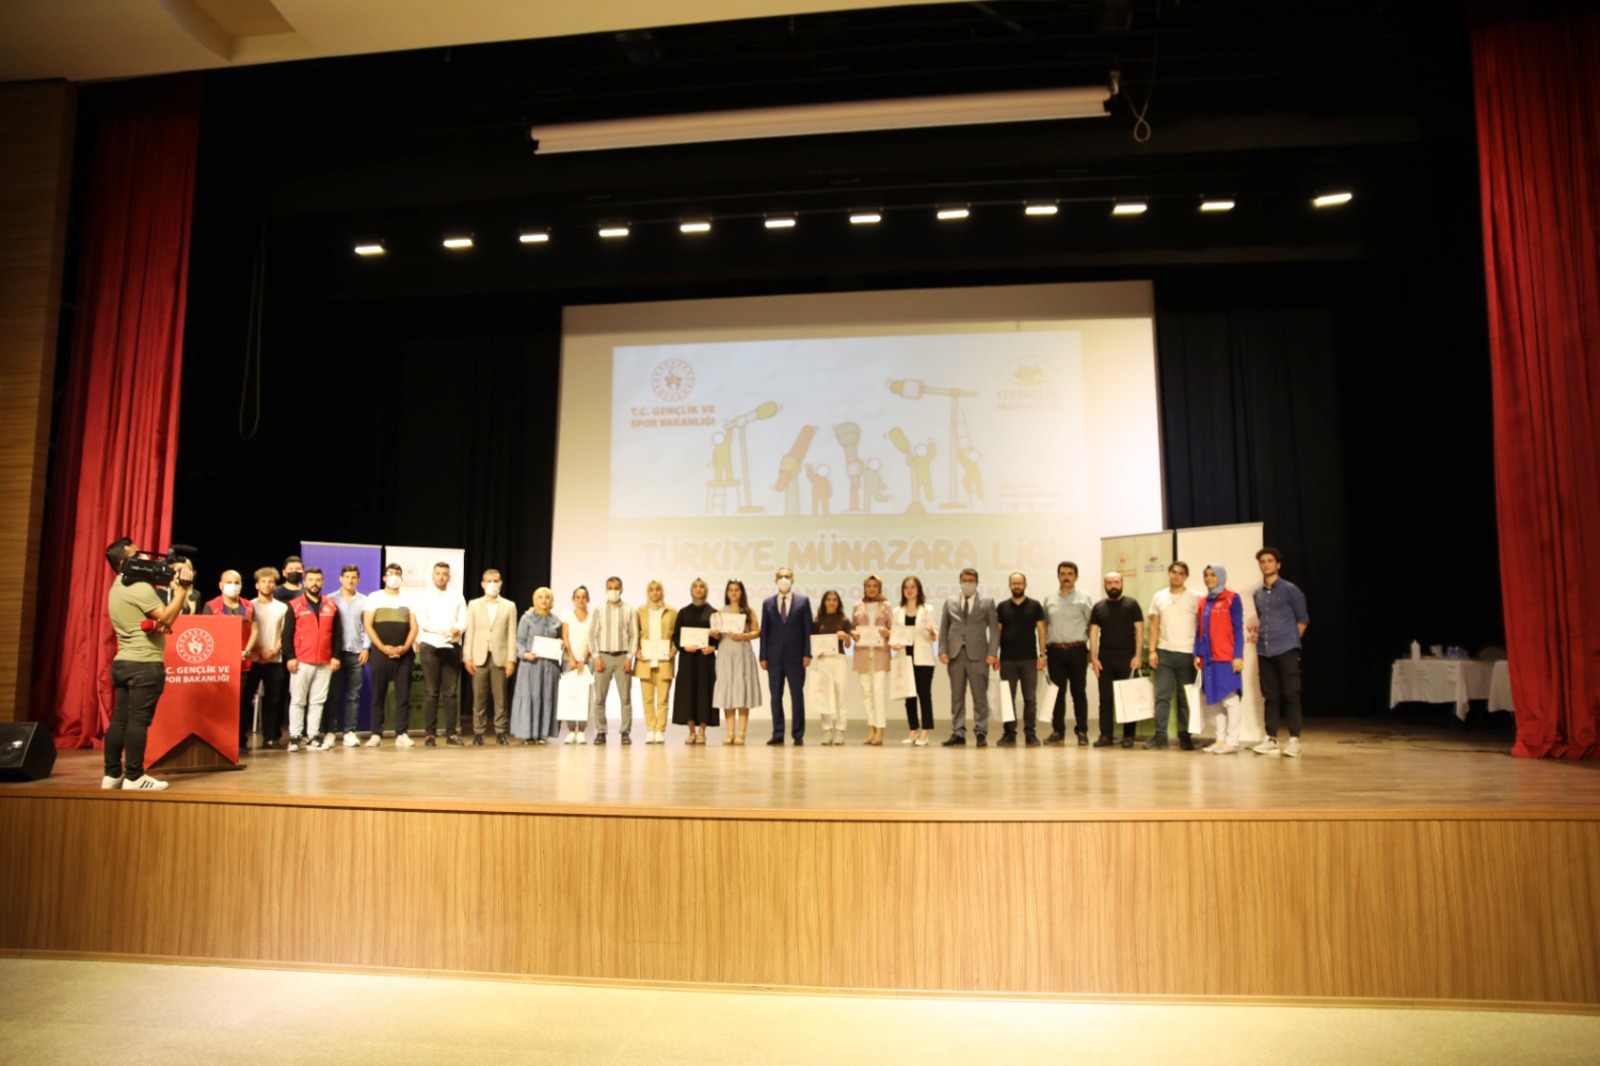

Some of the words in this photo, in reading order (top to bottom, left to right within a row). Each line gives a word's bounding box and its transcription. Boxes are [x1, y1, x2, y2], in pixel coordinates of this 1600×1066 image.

[652, 404, 698, 417] GENÇLİK
[701, 405, 715, 414] VE
[630, 418, 657, 428] SPOR
[660, 415, 715, 427] BAKANLIĞI
[640, 535, 775, 572] TÜRKİYE
[788, 532, 977, 572] MÜNAZARA
[991, 536, 1057, 571] LİGİ
[176, 665, 216, 675] GENÇLİK
[218, 665, 230, 673] VE
[165, 676, 181, 684] POR
[184, 674, 230, 683] BAKANLIĞI
